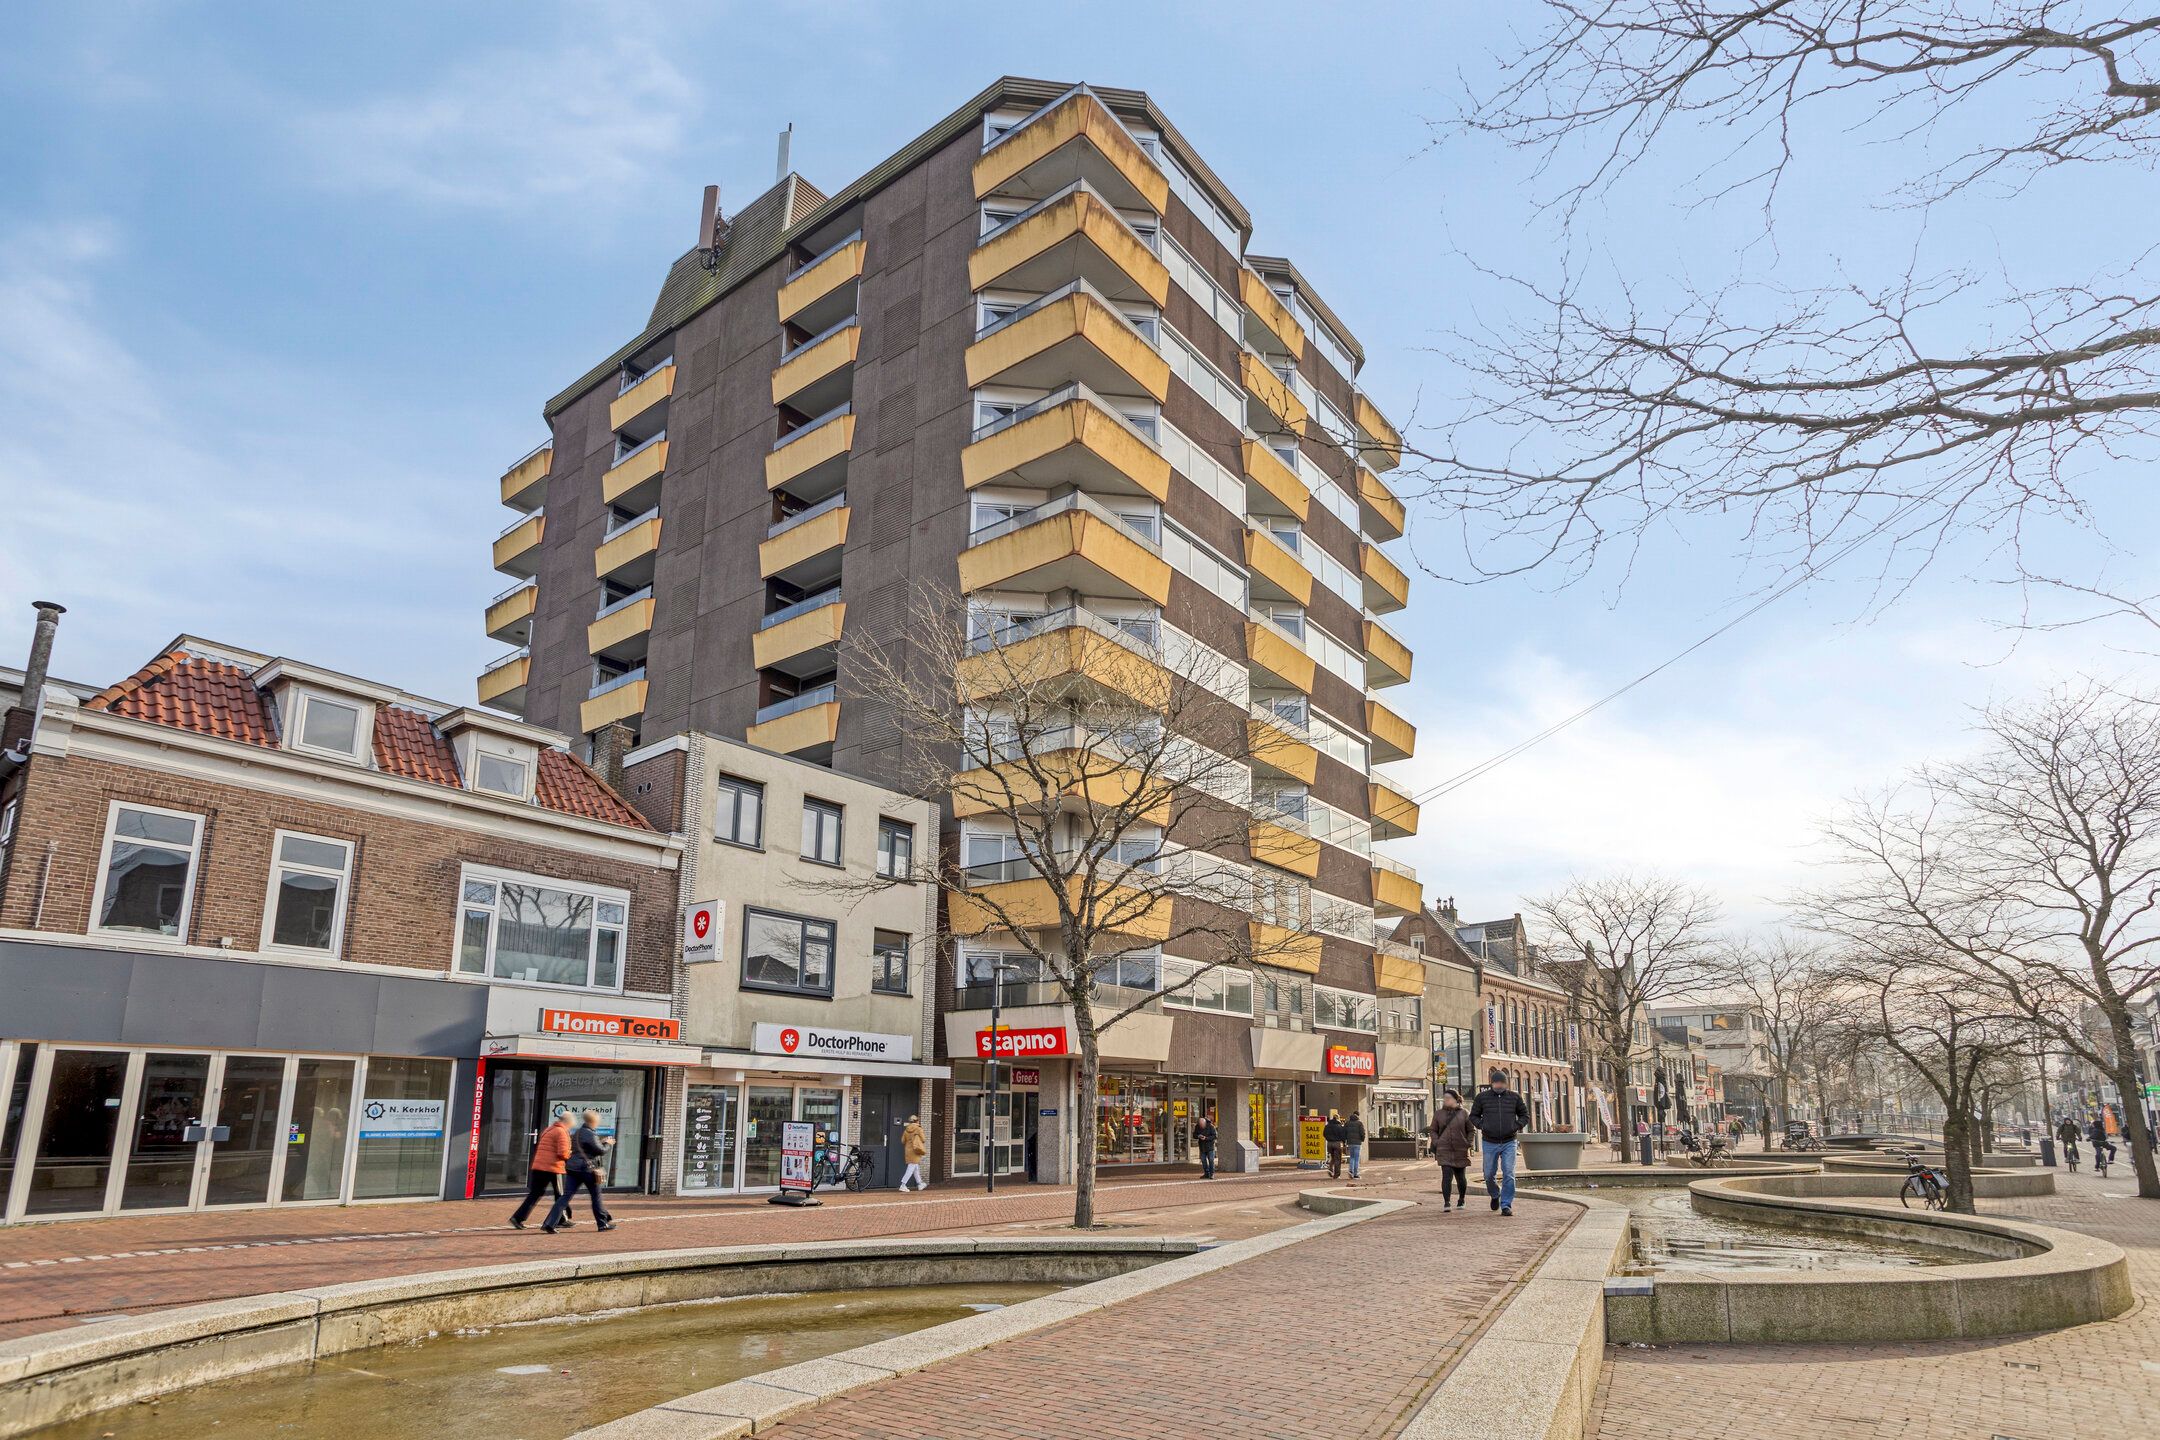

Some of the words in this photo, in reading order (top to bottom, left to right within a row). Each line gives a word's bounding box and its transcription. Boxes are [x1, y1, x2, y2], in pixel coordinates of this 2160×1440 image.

[685, 944, 713, 952] DoctorPhone
[553, 1012, 670, 1038] HomeTech
[808, 1032, 886, 1053] DoctorPhone
[982, 1033, 1057, 1056] scapino
[1333, 1054, 1372, 1075] scapino
